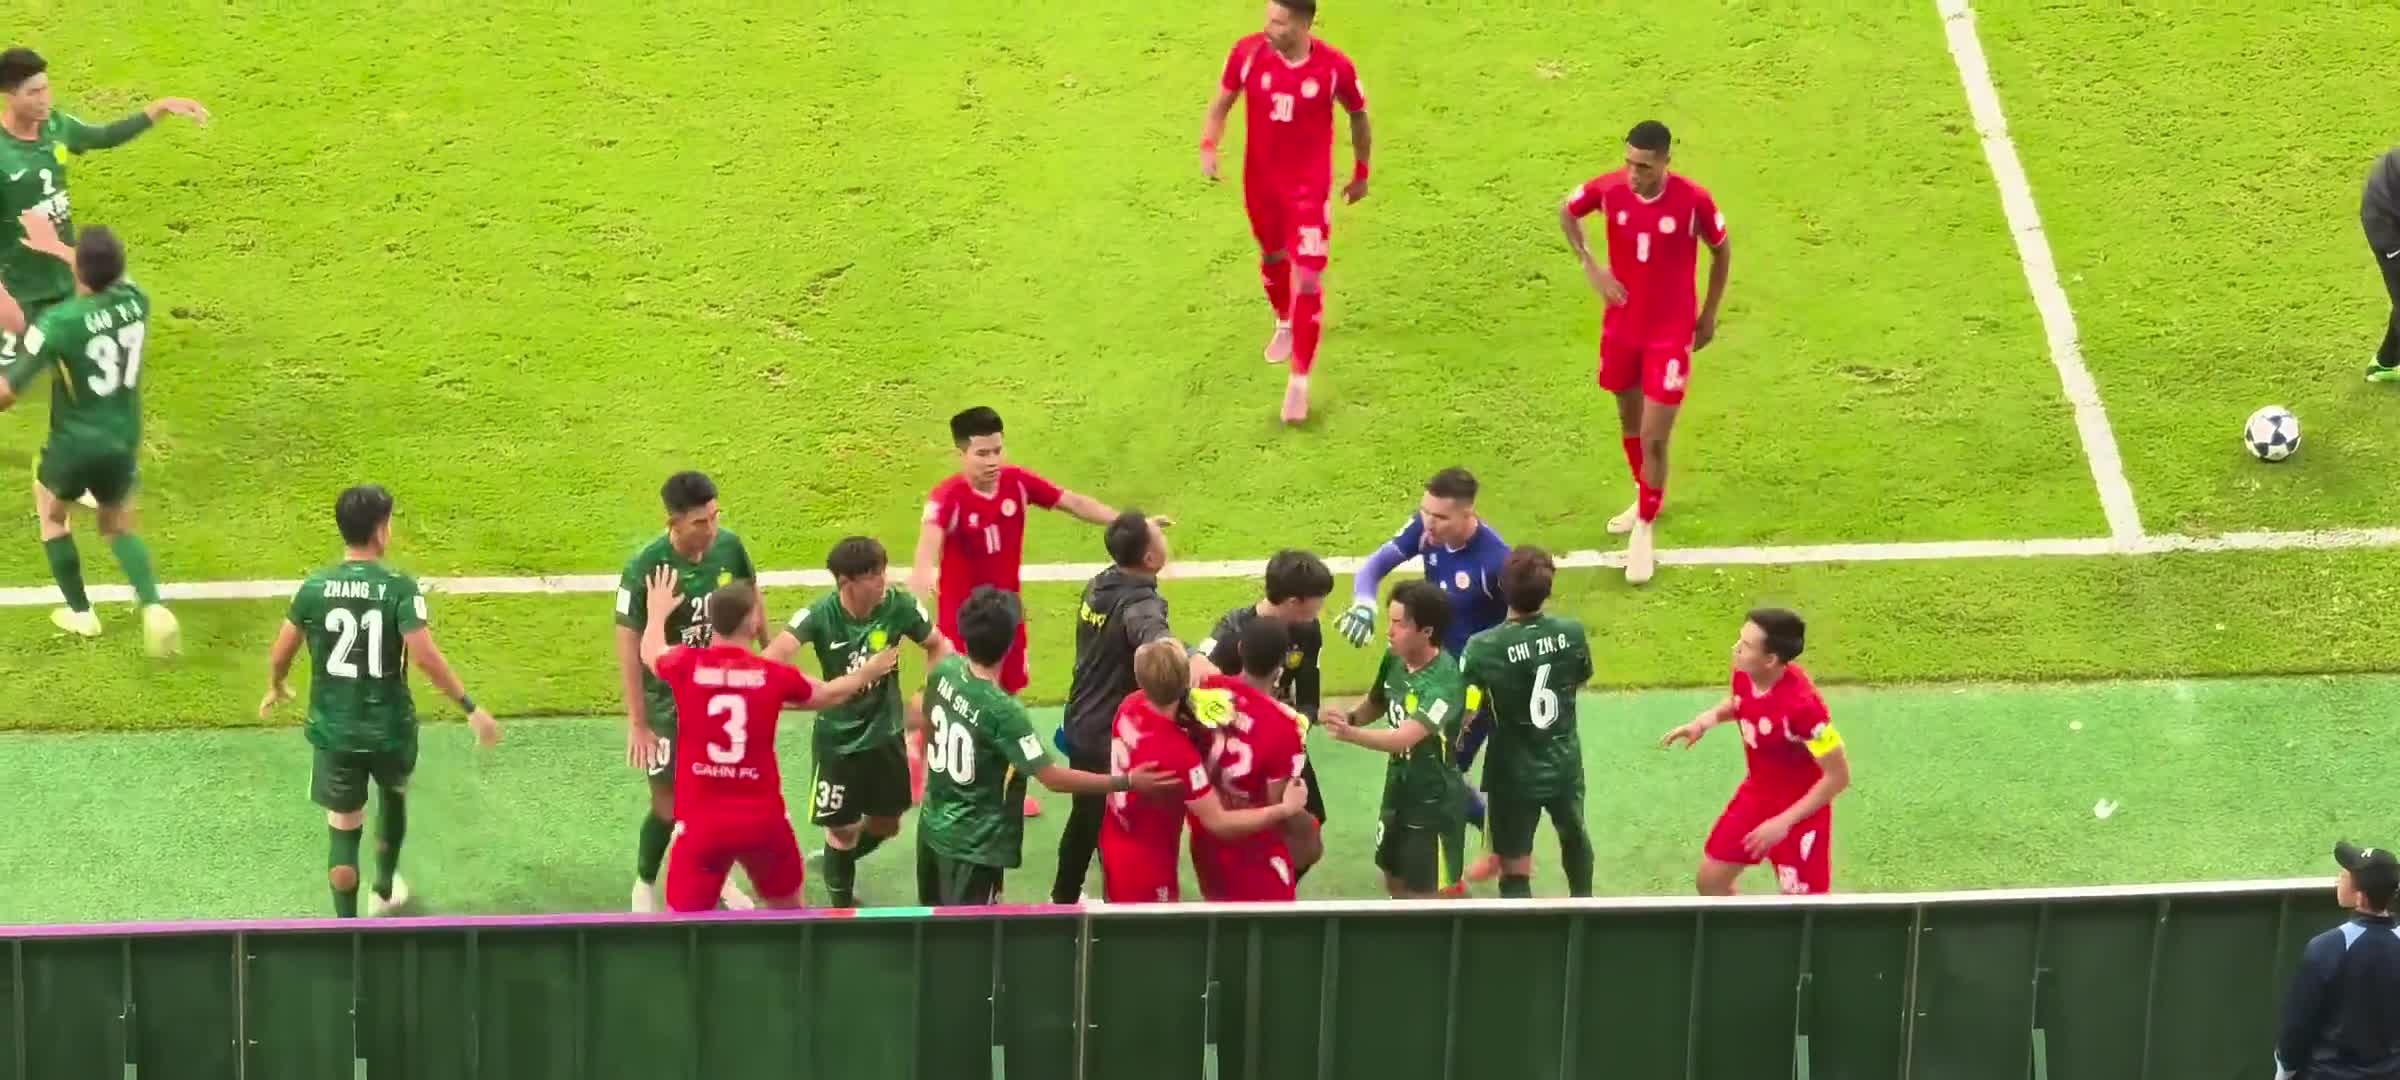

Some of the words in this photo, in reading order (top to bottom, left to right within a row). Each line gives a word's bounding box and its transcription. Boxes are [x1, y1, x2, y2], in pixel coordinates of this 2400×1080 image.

[1270, 92, 1295, 122] 30
[39, 168, 56, 195] 2
[1297, 225, 1322, 257] 30
[84, 320, 144, 397] 37
[983, 524, 1001, 554] 11
[323, 580, 370, 599] ZHANG
[325, 607, 383, 678] 21
[1507, 642, 1530, 663] CHI
[1529, 663, 1559, 728] 6
[707, 693, 748, 764] 3
[928, 704, 975, 786] 30
[692, 762, 736, 778] CAHN
[739, 767, 760, 780] FC
[816, 780, 846, 810] 35
